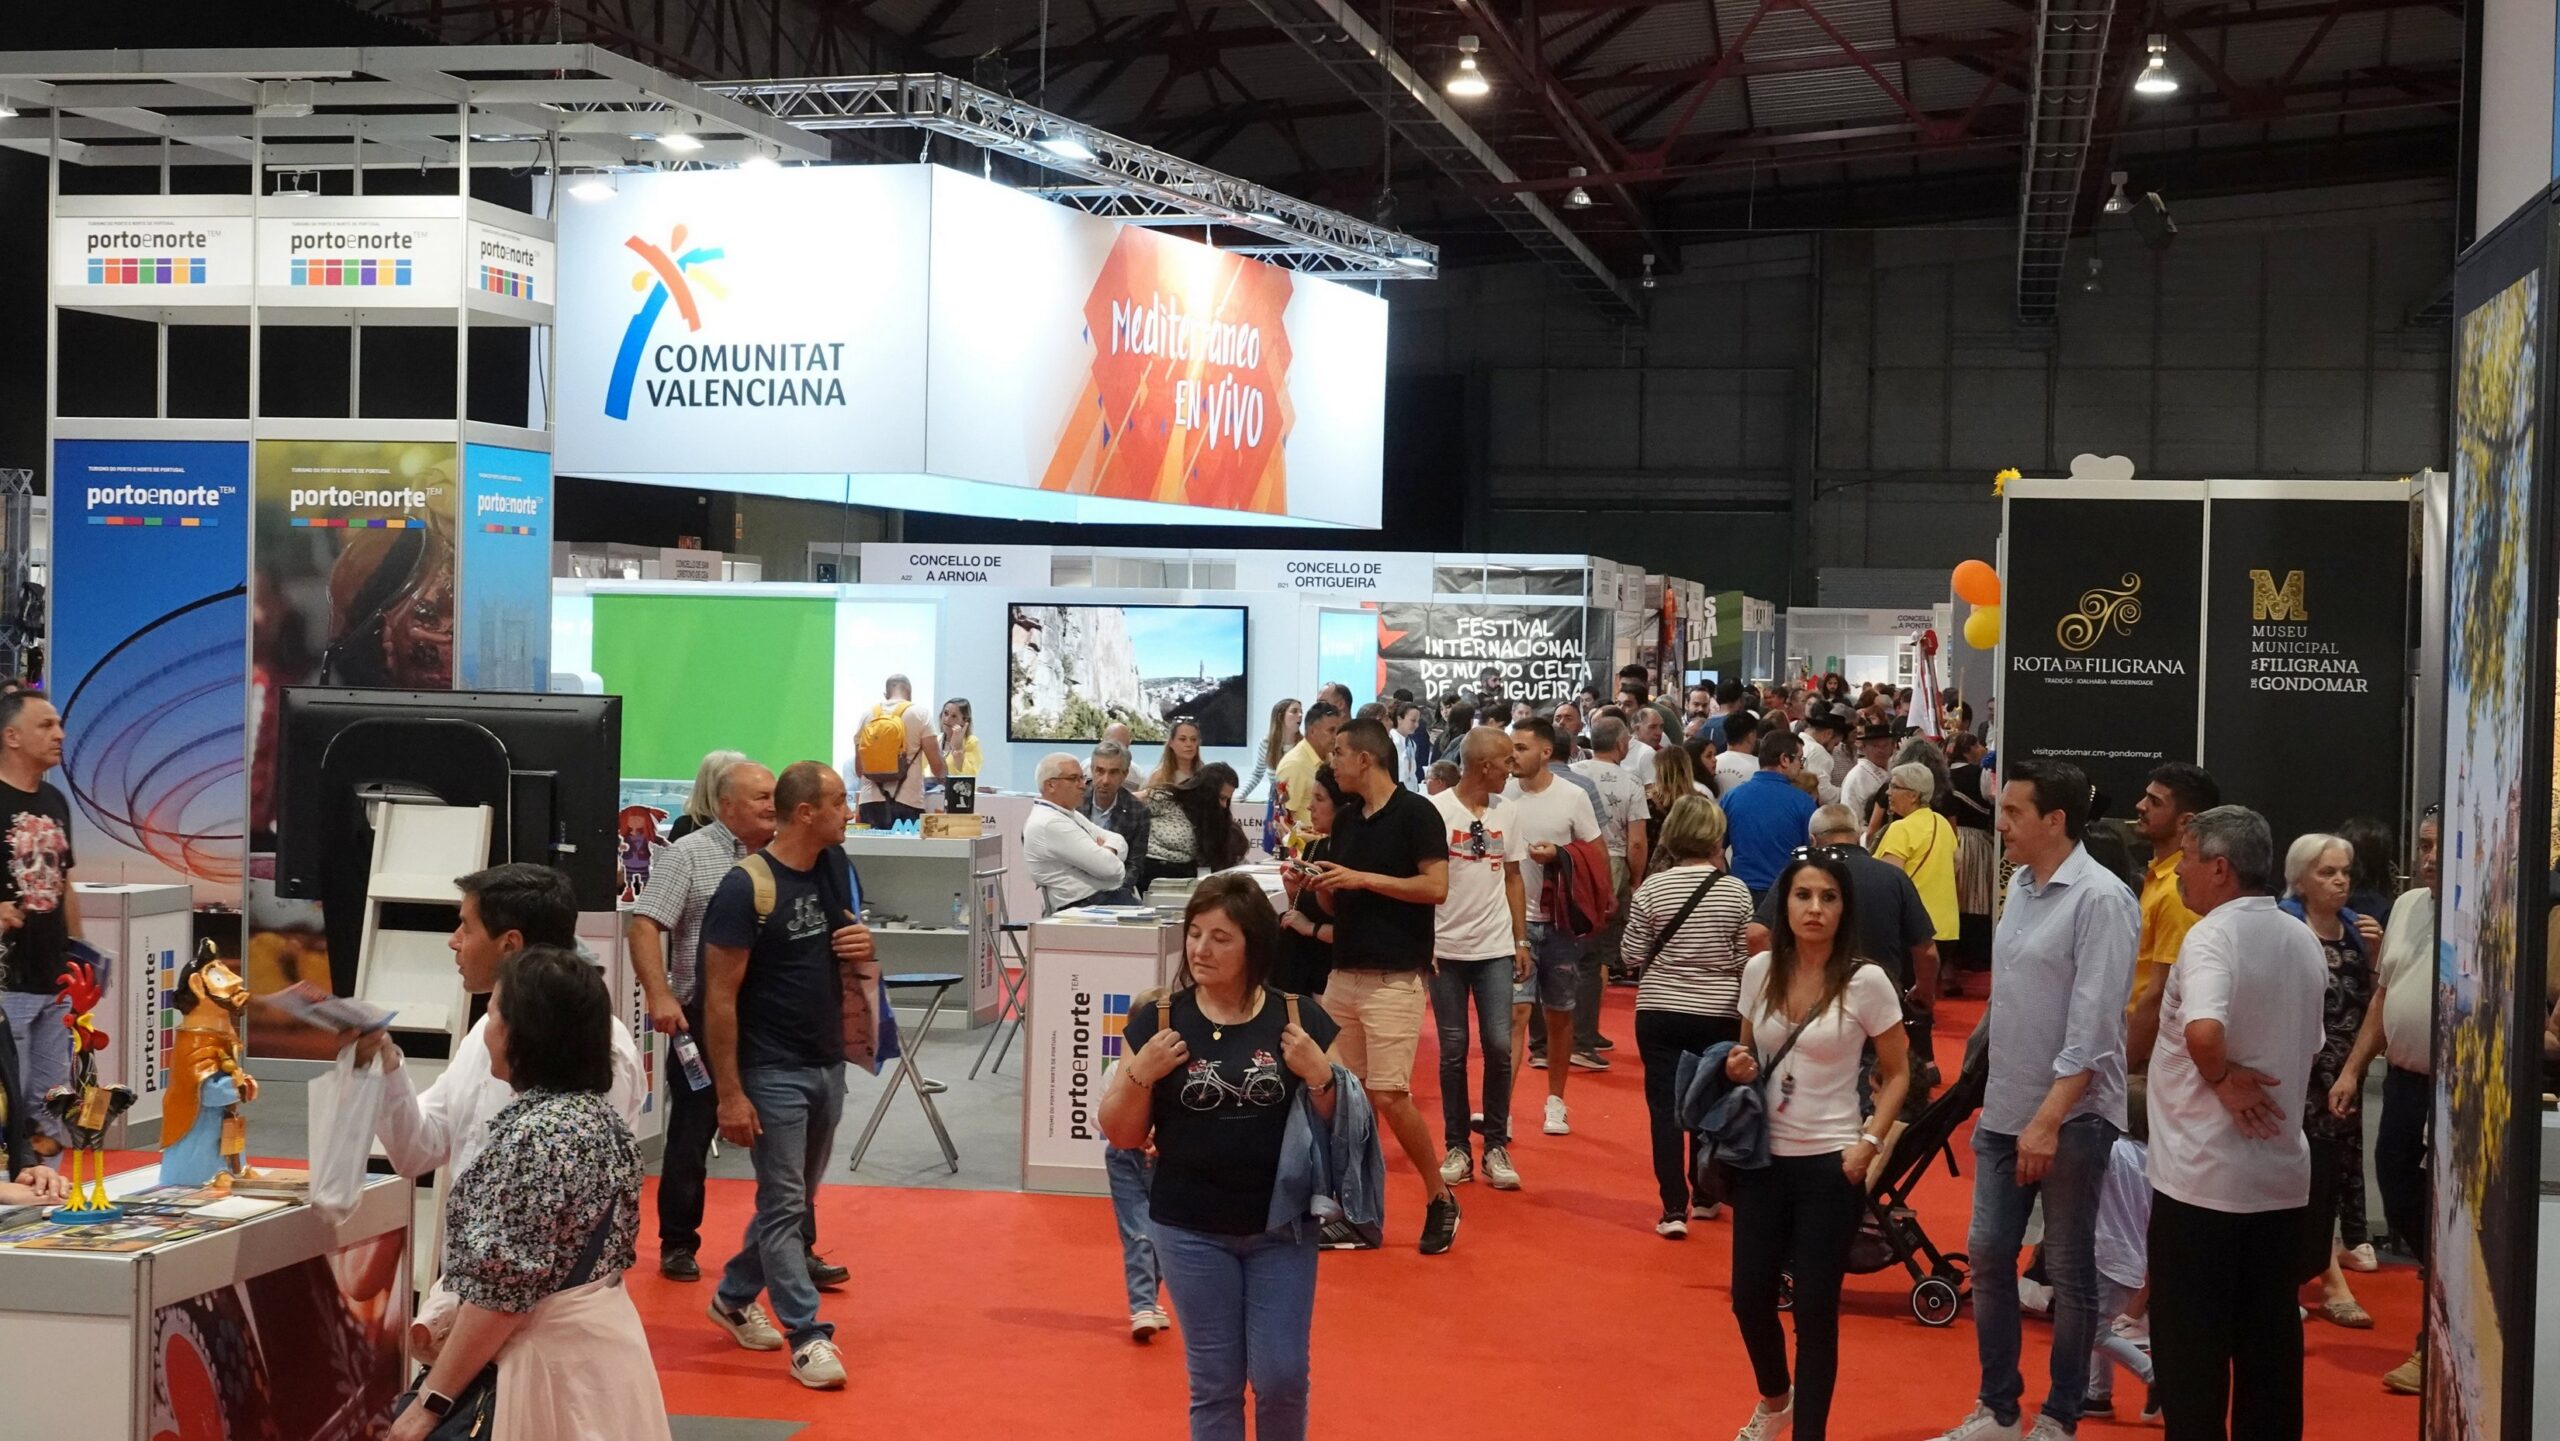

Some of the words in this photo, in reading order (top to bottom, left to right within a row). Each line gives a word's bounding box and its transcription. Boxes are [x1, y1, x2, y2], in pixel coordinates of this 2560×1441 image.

[88, 231, 206, 253] portoenorte
[291, 231, 412, 254] portoenorte
[655, 342, 845, 373] COMUNITAT
[646, 378, 846, 407] VALENCIANA
[1175, 379, 1201, 431] EN
[87, 484, 219, 510] portoenorte
[290, 486, 425, 511] portoenorte
[478, 492, 537, 517] portoenorte
[910, 555, 981, 567] CONCELLO
[984, 556, 1002, 567] DE
[1286, 562, 1360, 574] CONCELLO
[1364, 563, 1382, 574] DE
[926, 571, 935, 581] A
[938, 571, 988, 582] ARNOIA
[1295, 576, 1376, 588] ORTIGUEIRA
[1457, 617, 1554, 638] FESTIVAL
[2252, 625, 2308, 638] MUSEU
[1425, 636, 1587, 659] INTERNACIONAL
[2251, 641, 2339, 654] MUNICIPAL
[1420, 659, 1448, 680] DO
[1452, 660, 1523, 679] MUDO
[1530, 660, 1592, 681] CELTA
[2013, 656, 2063, 672] ROTA
[2065, 659, 2082, 670] DA
[2085, 658, 2186, 675] FILIGRANA
[2259, 657, 2361, 674] FILIGRANA
[2258, 676, 2369, 693] GONDOMAR
[2032, 747, 2163, 759] visitgondomar.cm-gondomar.pt
[1071, 974, 1079, 991] TEM
[144, 953, 156, 1093] portoenorte
[1069, 992, 1092, 1140] portoenorte
